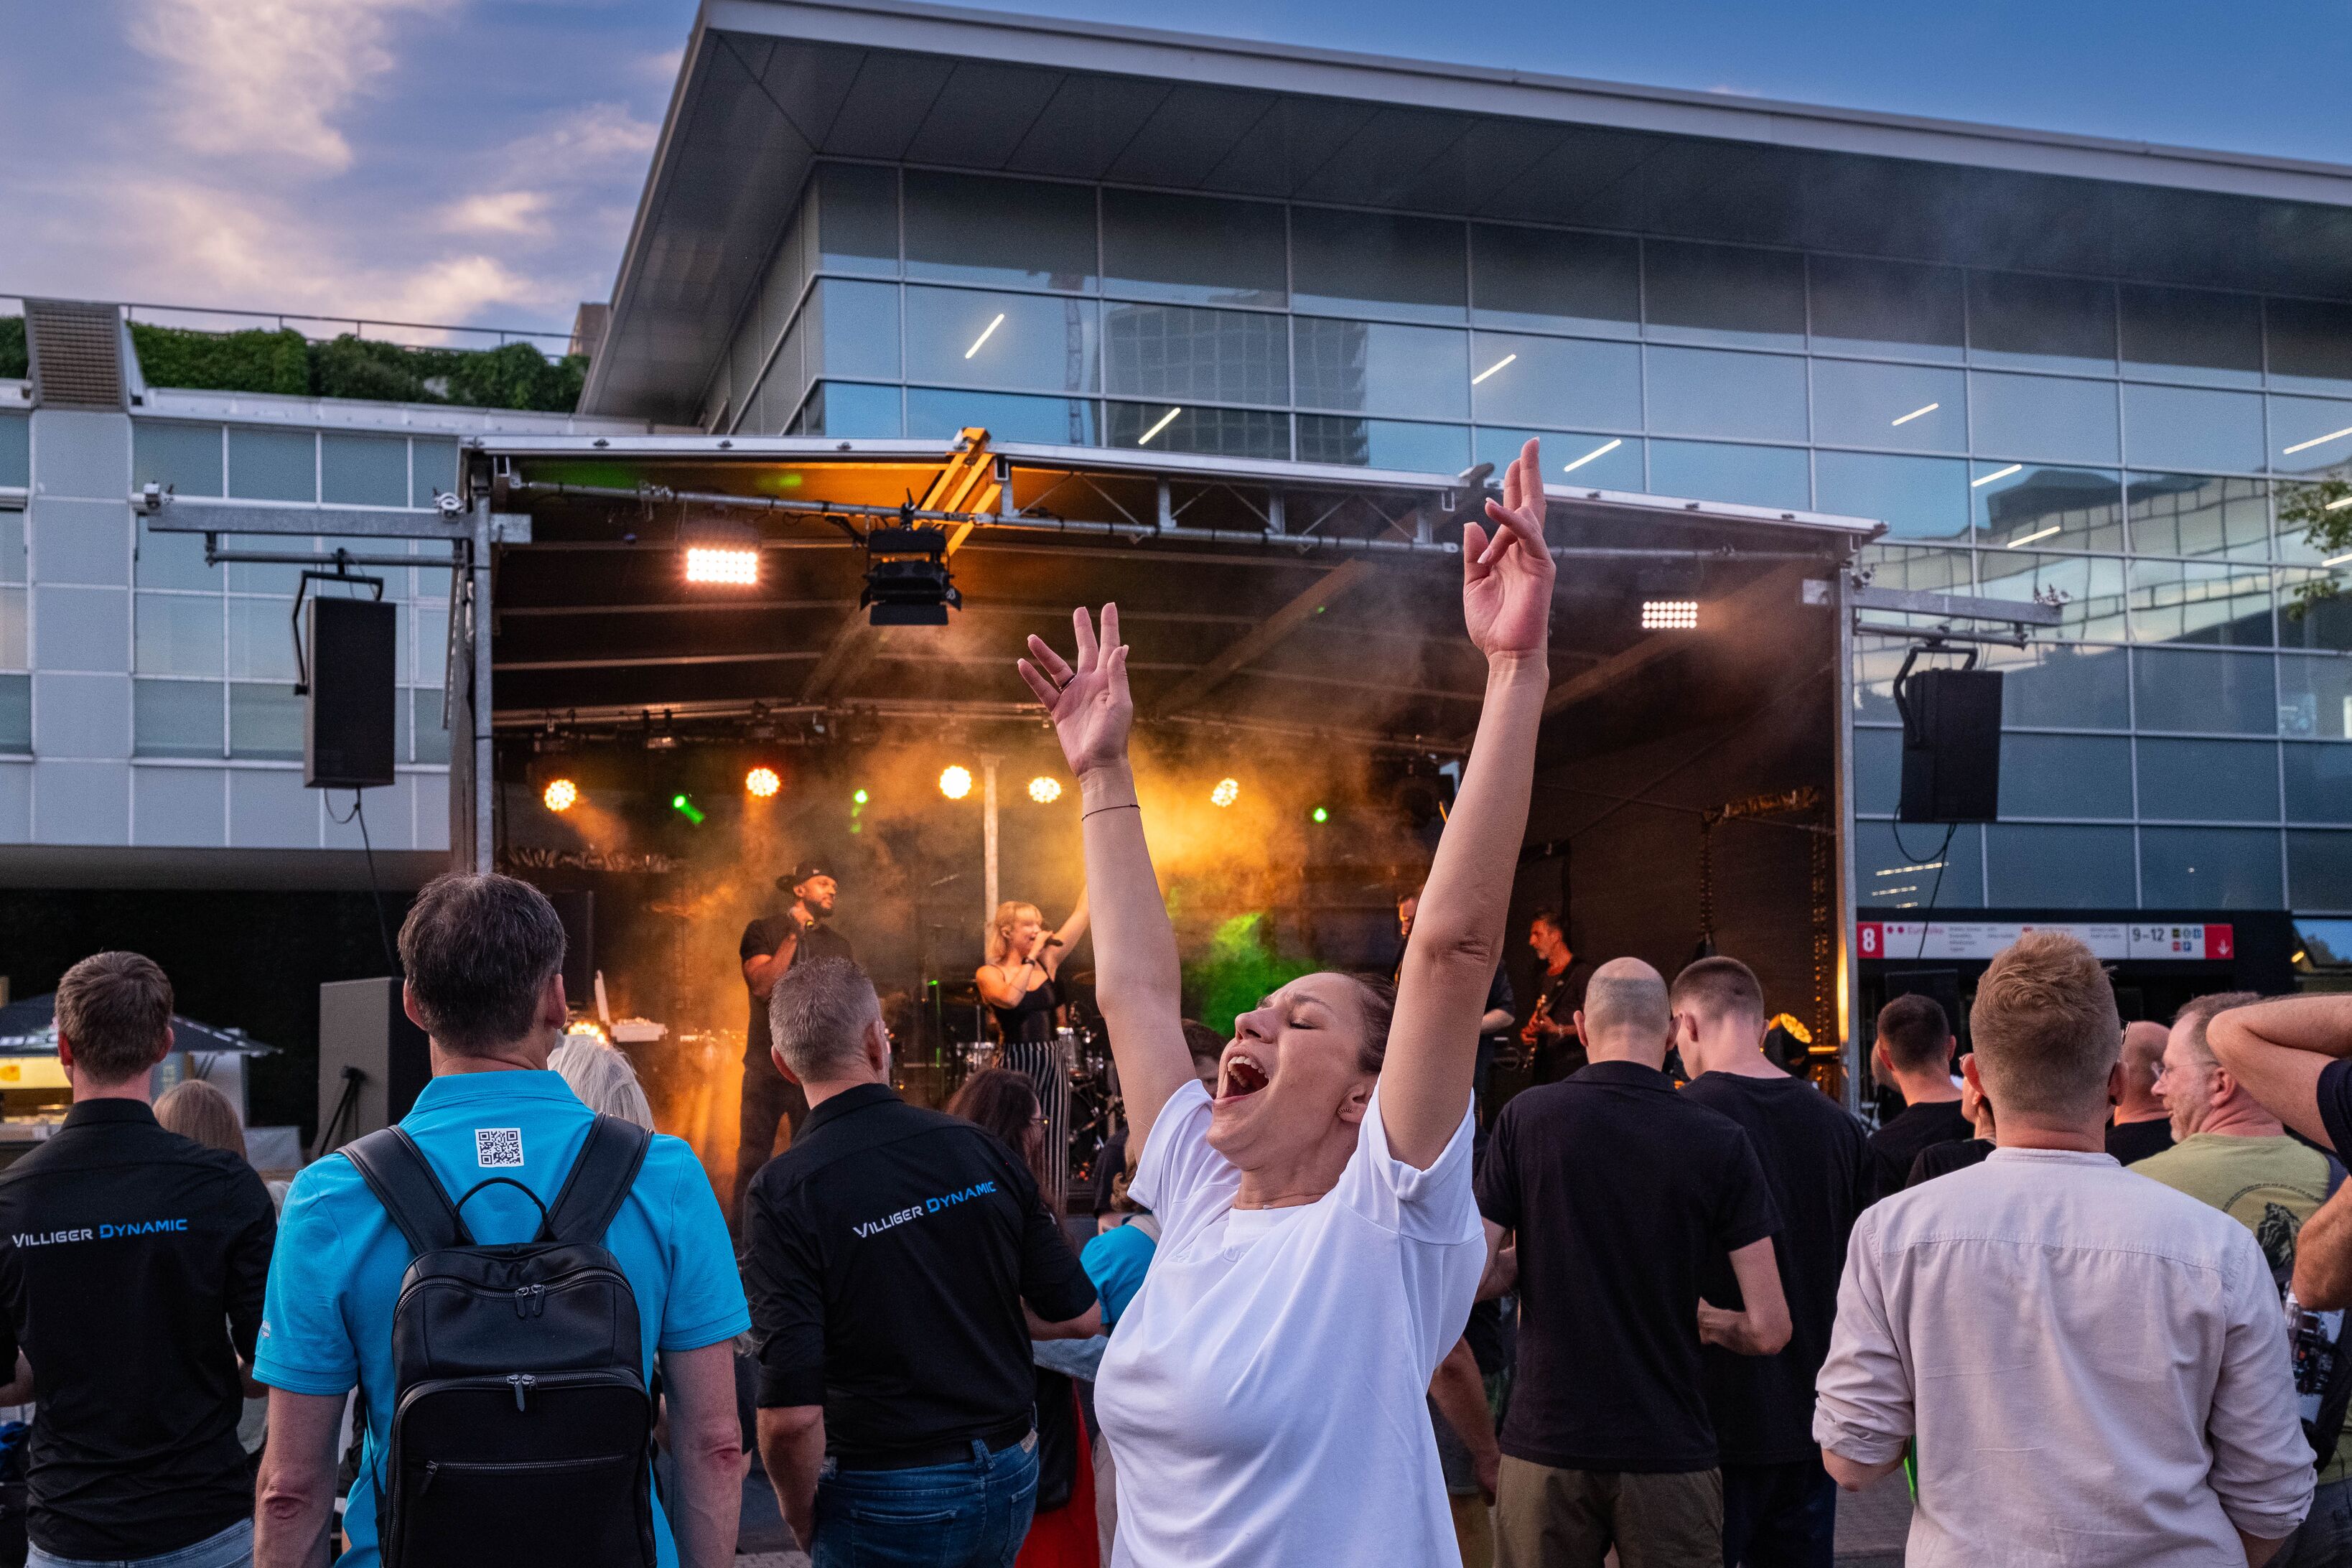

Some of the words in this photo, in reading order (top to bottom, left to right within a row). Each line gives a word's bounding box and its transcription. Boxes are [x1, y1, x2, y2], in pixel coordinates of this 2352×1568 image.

[1862, 928, 1875, 952] 8
[853, 1205, 924, 1238] VILLIGER
[925, 1181, 997, 1213] DYNAMIC
[11, 1228, 93, 1248] VILLIGER
[99, 1218, 188, 1239] DYNAMIC
